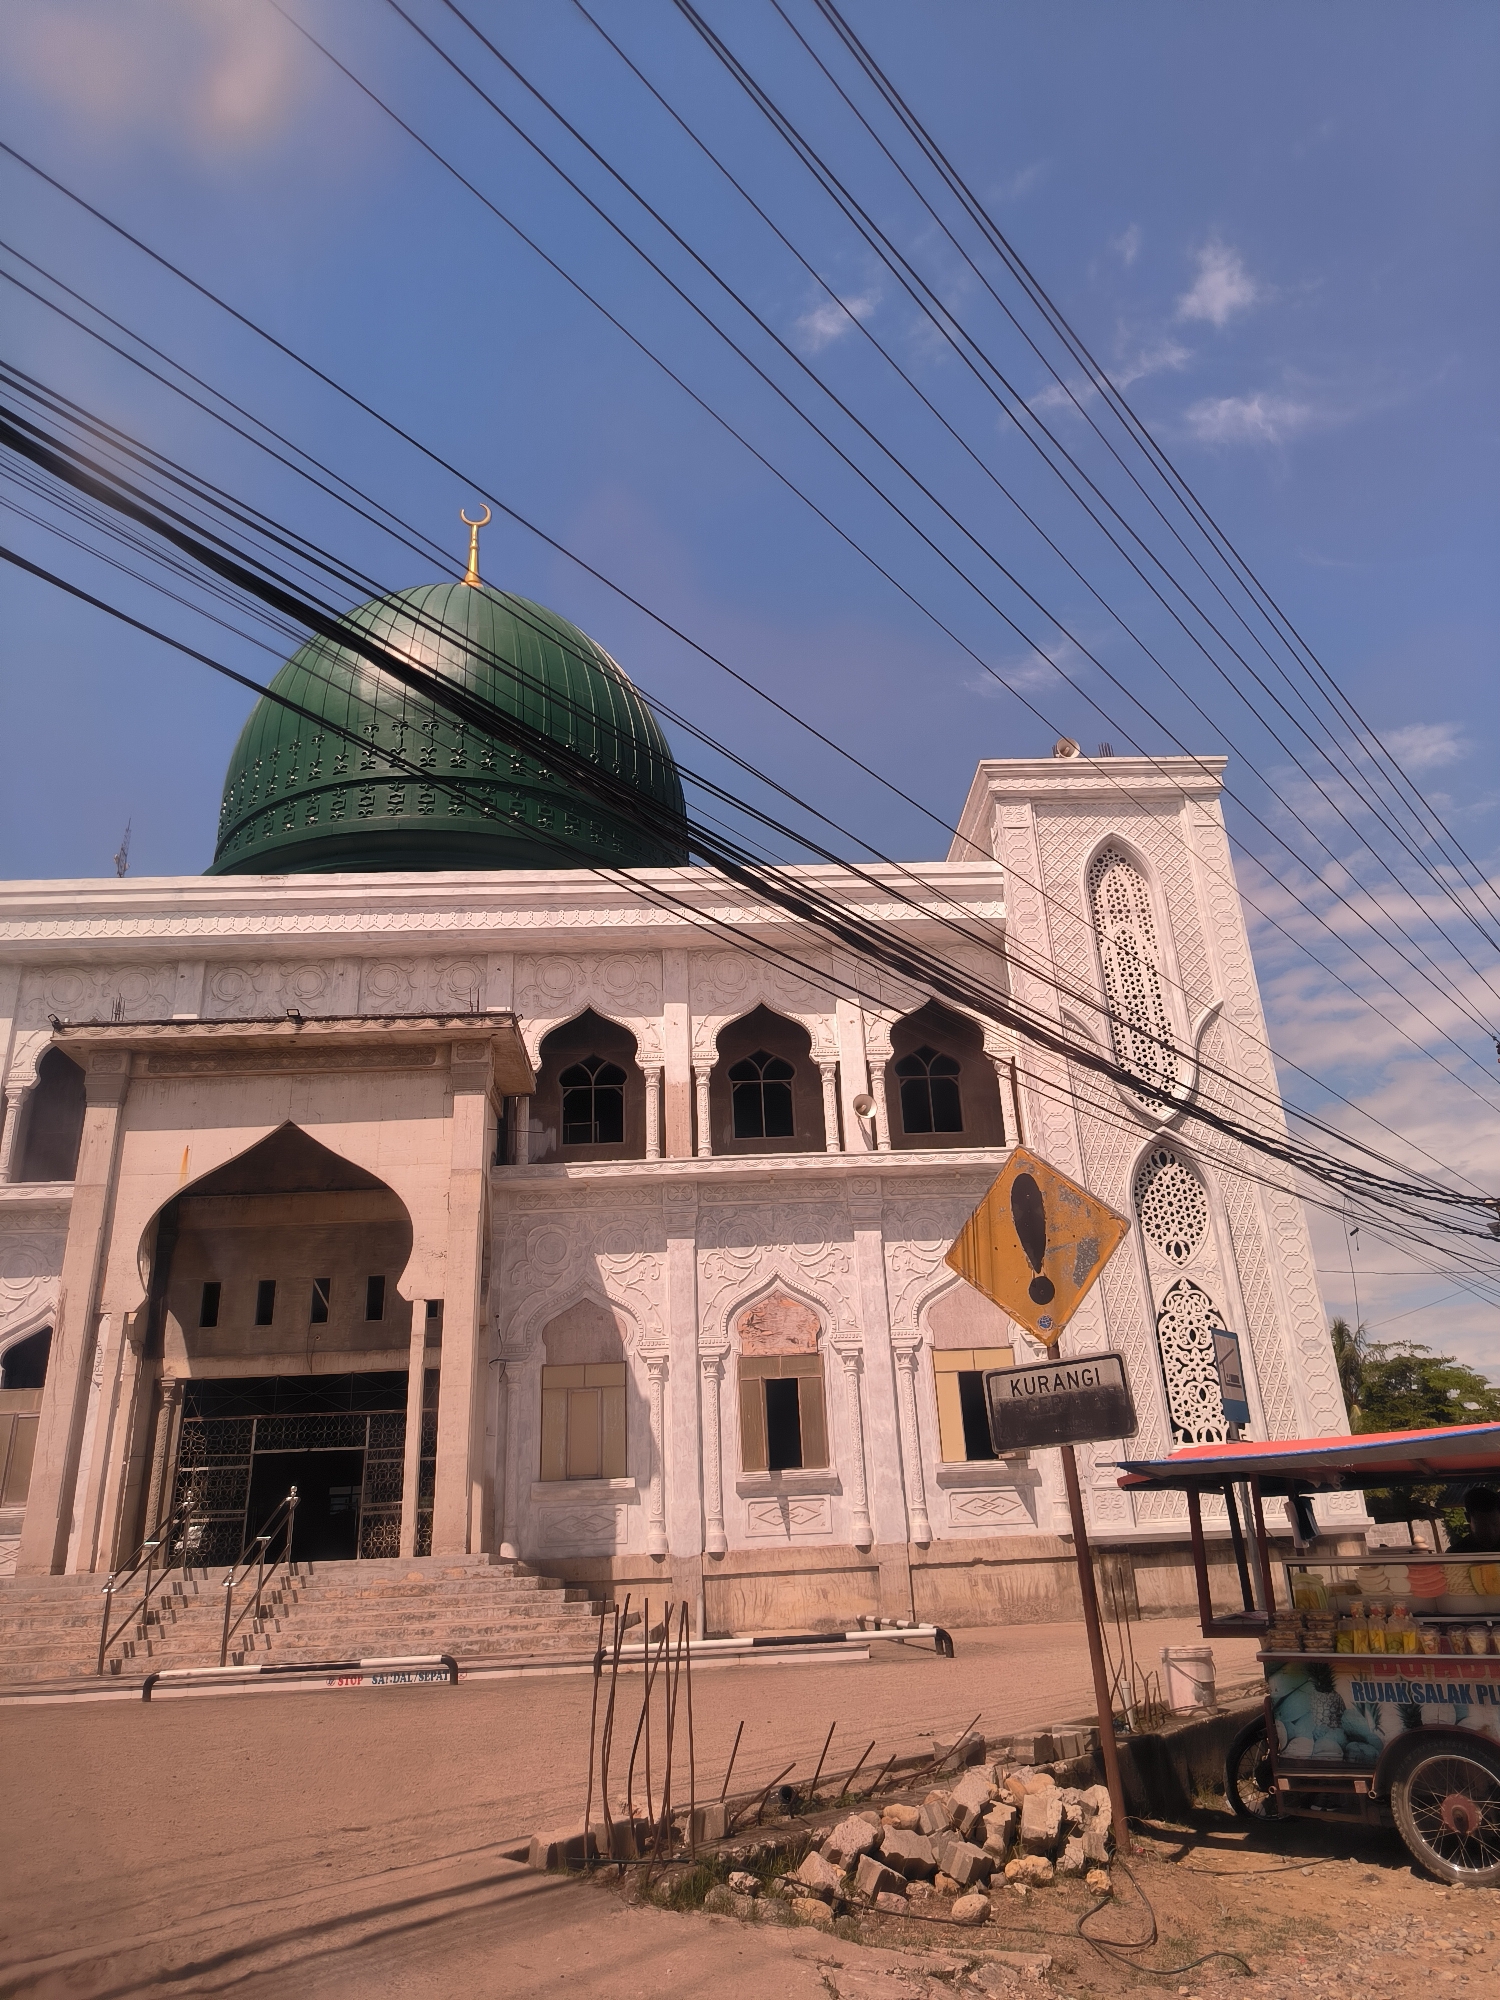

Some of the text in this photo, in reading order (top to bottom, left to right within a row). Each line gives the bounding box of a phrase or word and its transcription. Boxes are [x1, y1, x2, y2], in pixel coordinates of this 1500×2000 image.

[1010, 1367, 1100, 1397] KURANGI
[338, 1675, 363, 1686] STOP
[1351, 1681, 1500, 1705] RUJAK SALAK PL
